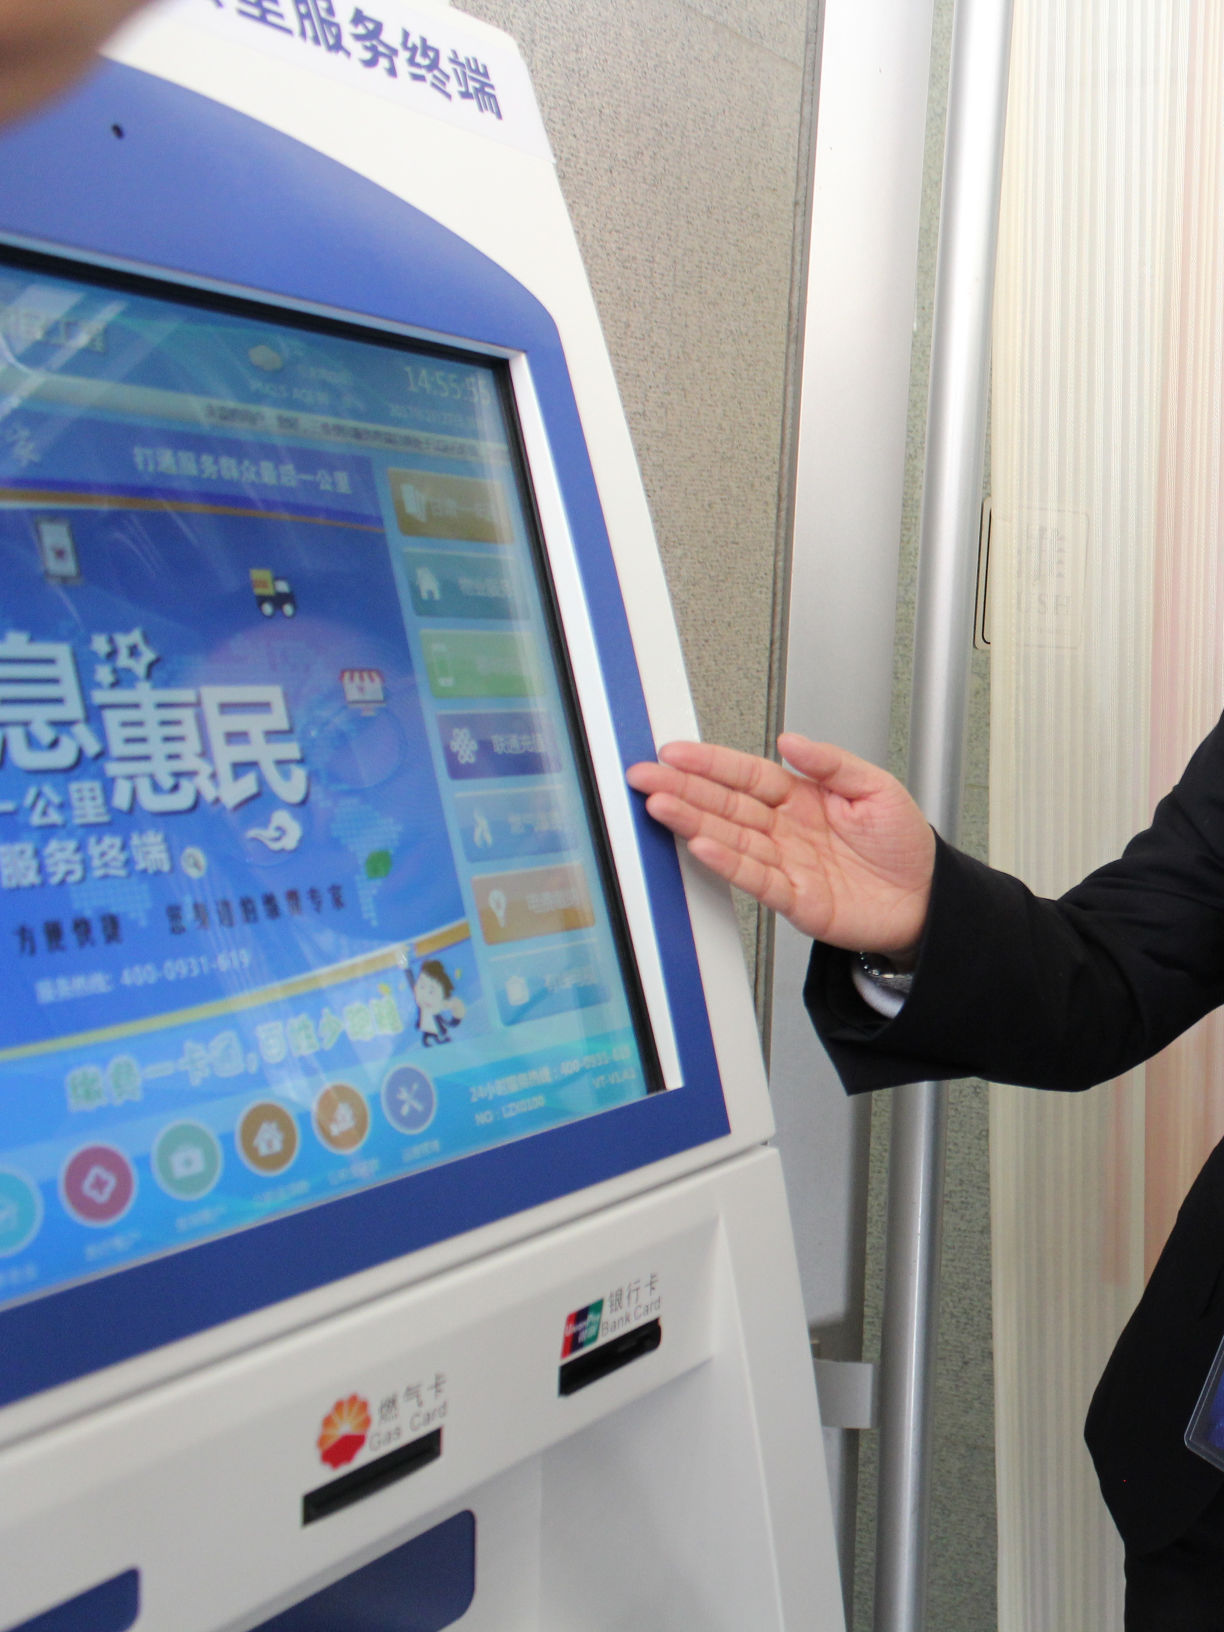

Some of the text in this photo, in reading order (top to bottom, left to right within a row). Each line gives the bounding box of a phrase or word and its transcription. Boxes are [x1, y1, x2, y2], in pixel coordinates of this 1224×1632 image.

[212, 0, 503, 121] 里服务终端
[0, 830, 171, 889] 服务终端
[601, 1311, 631, 1338] Bank
[634, 1295, 662, 1321] Card
[608, 1273, 660, 1315] 银行卡
[377, 1373, 448, 1423] 燃气卡
[368, 1398, 448, 1452] Gas Card
